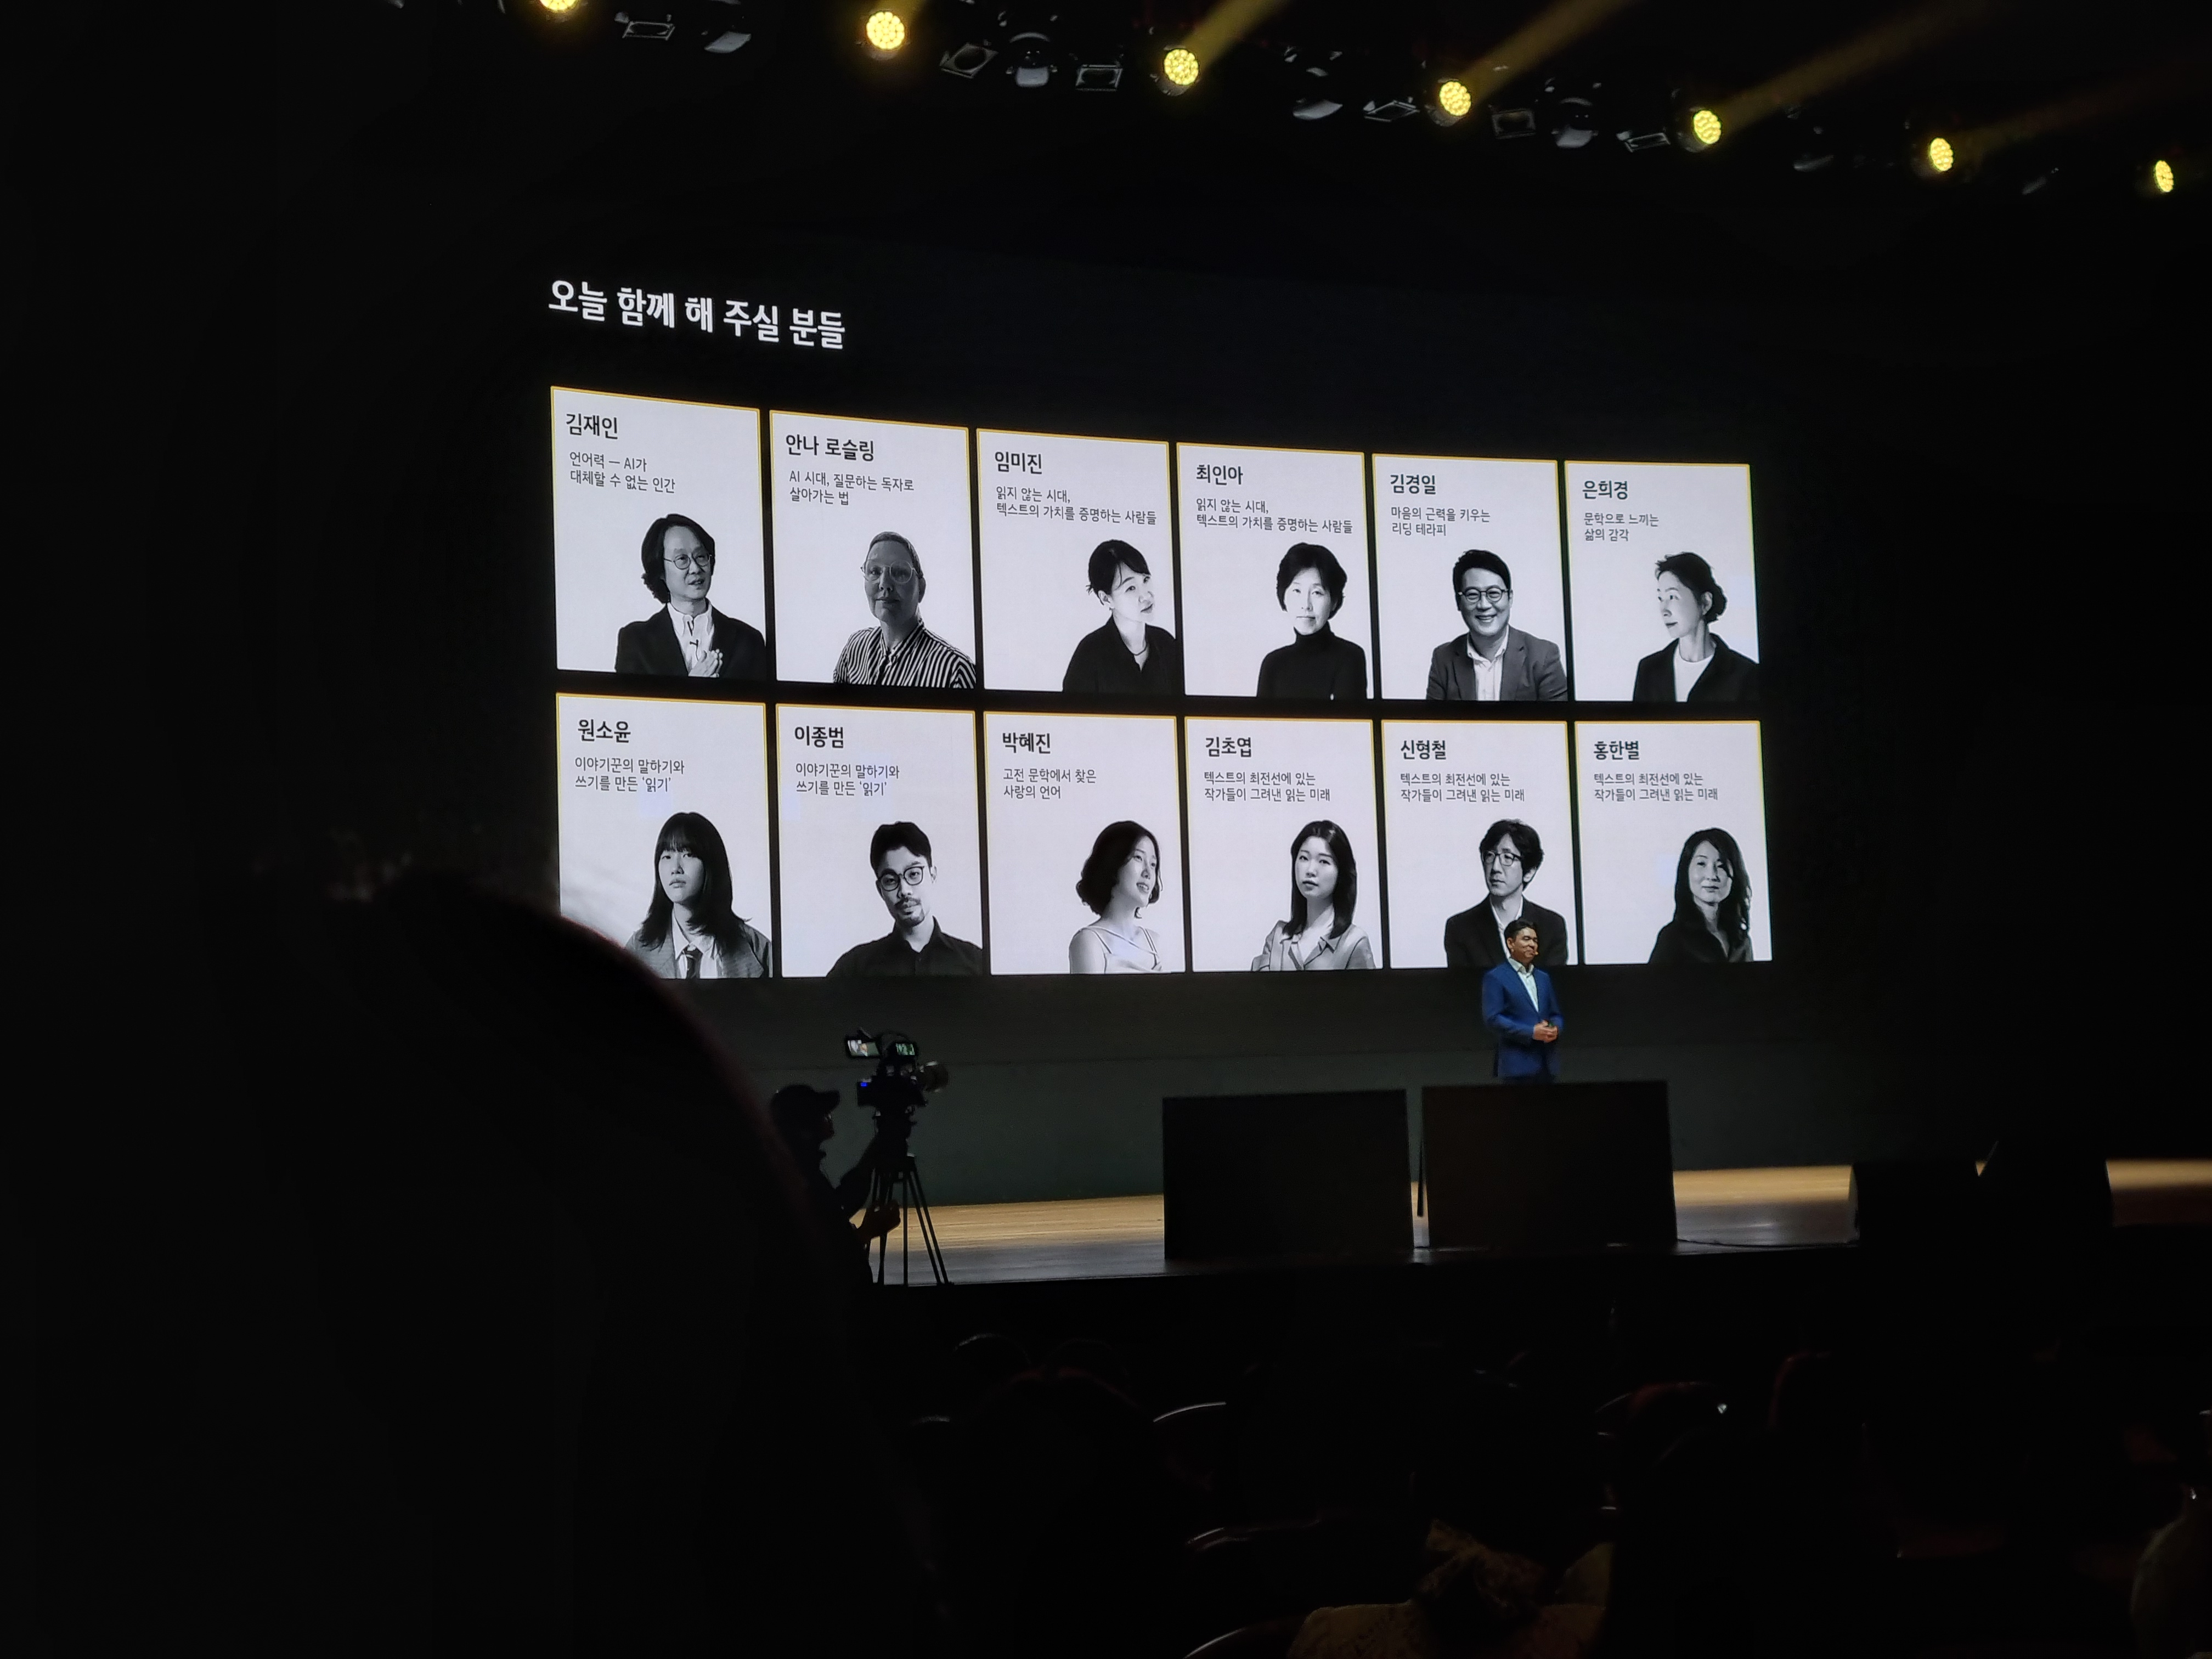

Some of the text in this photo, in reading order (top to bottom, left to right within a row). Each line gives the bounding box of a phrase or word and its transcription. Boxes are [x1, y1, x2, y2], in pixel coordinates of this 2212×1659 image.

[548, 280, 845, 349] 오늘 함께 해 주실 분들
[566, 413, 618, 440] 김재인
[786, 433, 874, 462] 안나 로슬링
[569, 452, 605, 470] 언어력
[623, 457, 647, 473] AI가
[994, 451, 1042, 475] 임미진
[570, 469, 676, 494] 대체할 수 없는 인간
[789, 470, 915, 492] AI 시대, 질문하는 독자로
[1196, 464, 1244, 486] 최인아
[1390, 473, 1436, 495] 김경일
[789, 487, 849, 506] 살아가는 법
[996, 486, 1071, 504] 읽지 않는 시대,
[1582, 480, 1628, 500] 은희경
[996, 502, 1157, 526] 텍스트의 가치를 증명하는 사람들
[1196, 498, 1269, 515] 읽지 않는 시대,
[1391, 506, 1491, 523] 마음의 근력을 키우는
[1197, 514, 1353, 534] 텍스트의 가치를 증명하는 사람들
[1583, 512, 1659, 527] 문학으로 느끼는
[1392, 522, 1446, 537] 리딩 테라피
[1584, 528, 1629, 542] 삶의 감각
[577, 719, 631, 743] 원소윤
[794, 725, 844, 749] 이종범
[1002, 732, 1051, 754] 박혜진
[1205, 736, 1252, 758] 김초엽
[1400, 740, 1447, 760] 신형철
[1593, 740, 1640, 760] 홍한별
[575, 757, 685, 775] 이야기꾼의 말하기와
[795, 763, 900, 780] 이야기꾼의 말하기와
[1003, 768, 1097, 783] 고전 문학에서 찾은
[575, 775, 611, 791] 쓰기를
[614, 776, 638, 792] 만든
[1204, 771, 1316, 786] 텍스트의 최전선에 있는
[1400, 772, 1511, 787] 텍스트의 최전선에 있는
[1594, 772, 1703, 787] 텍스트의 최전선에 있는
[796, 780, 830, 795] 쓰기를
[833, 781, 856, 797] 만든
[1003, 785, 1061, 800] 사랑의 언어
[1204, 787, 1330, 802] 작가들이 그려낸 읽는 미래
[1401, 788, 1525, 803] 작가들이 그려낸 읽는 미래
[1594, 788, 1718, 802] 작가들이 그려낸 읽는 미래
